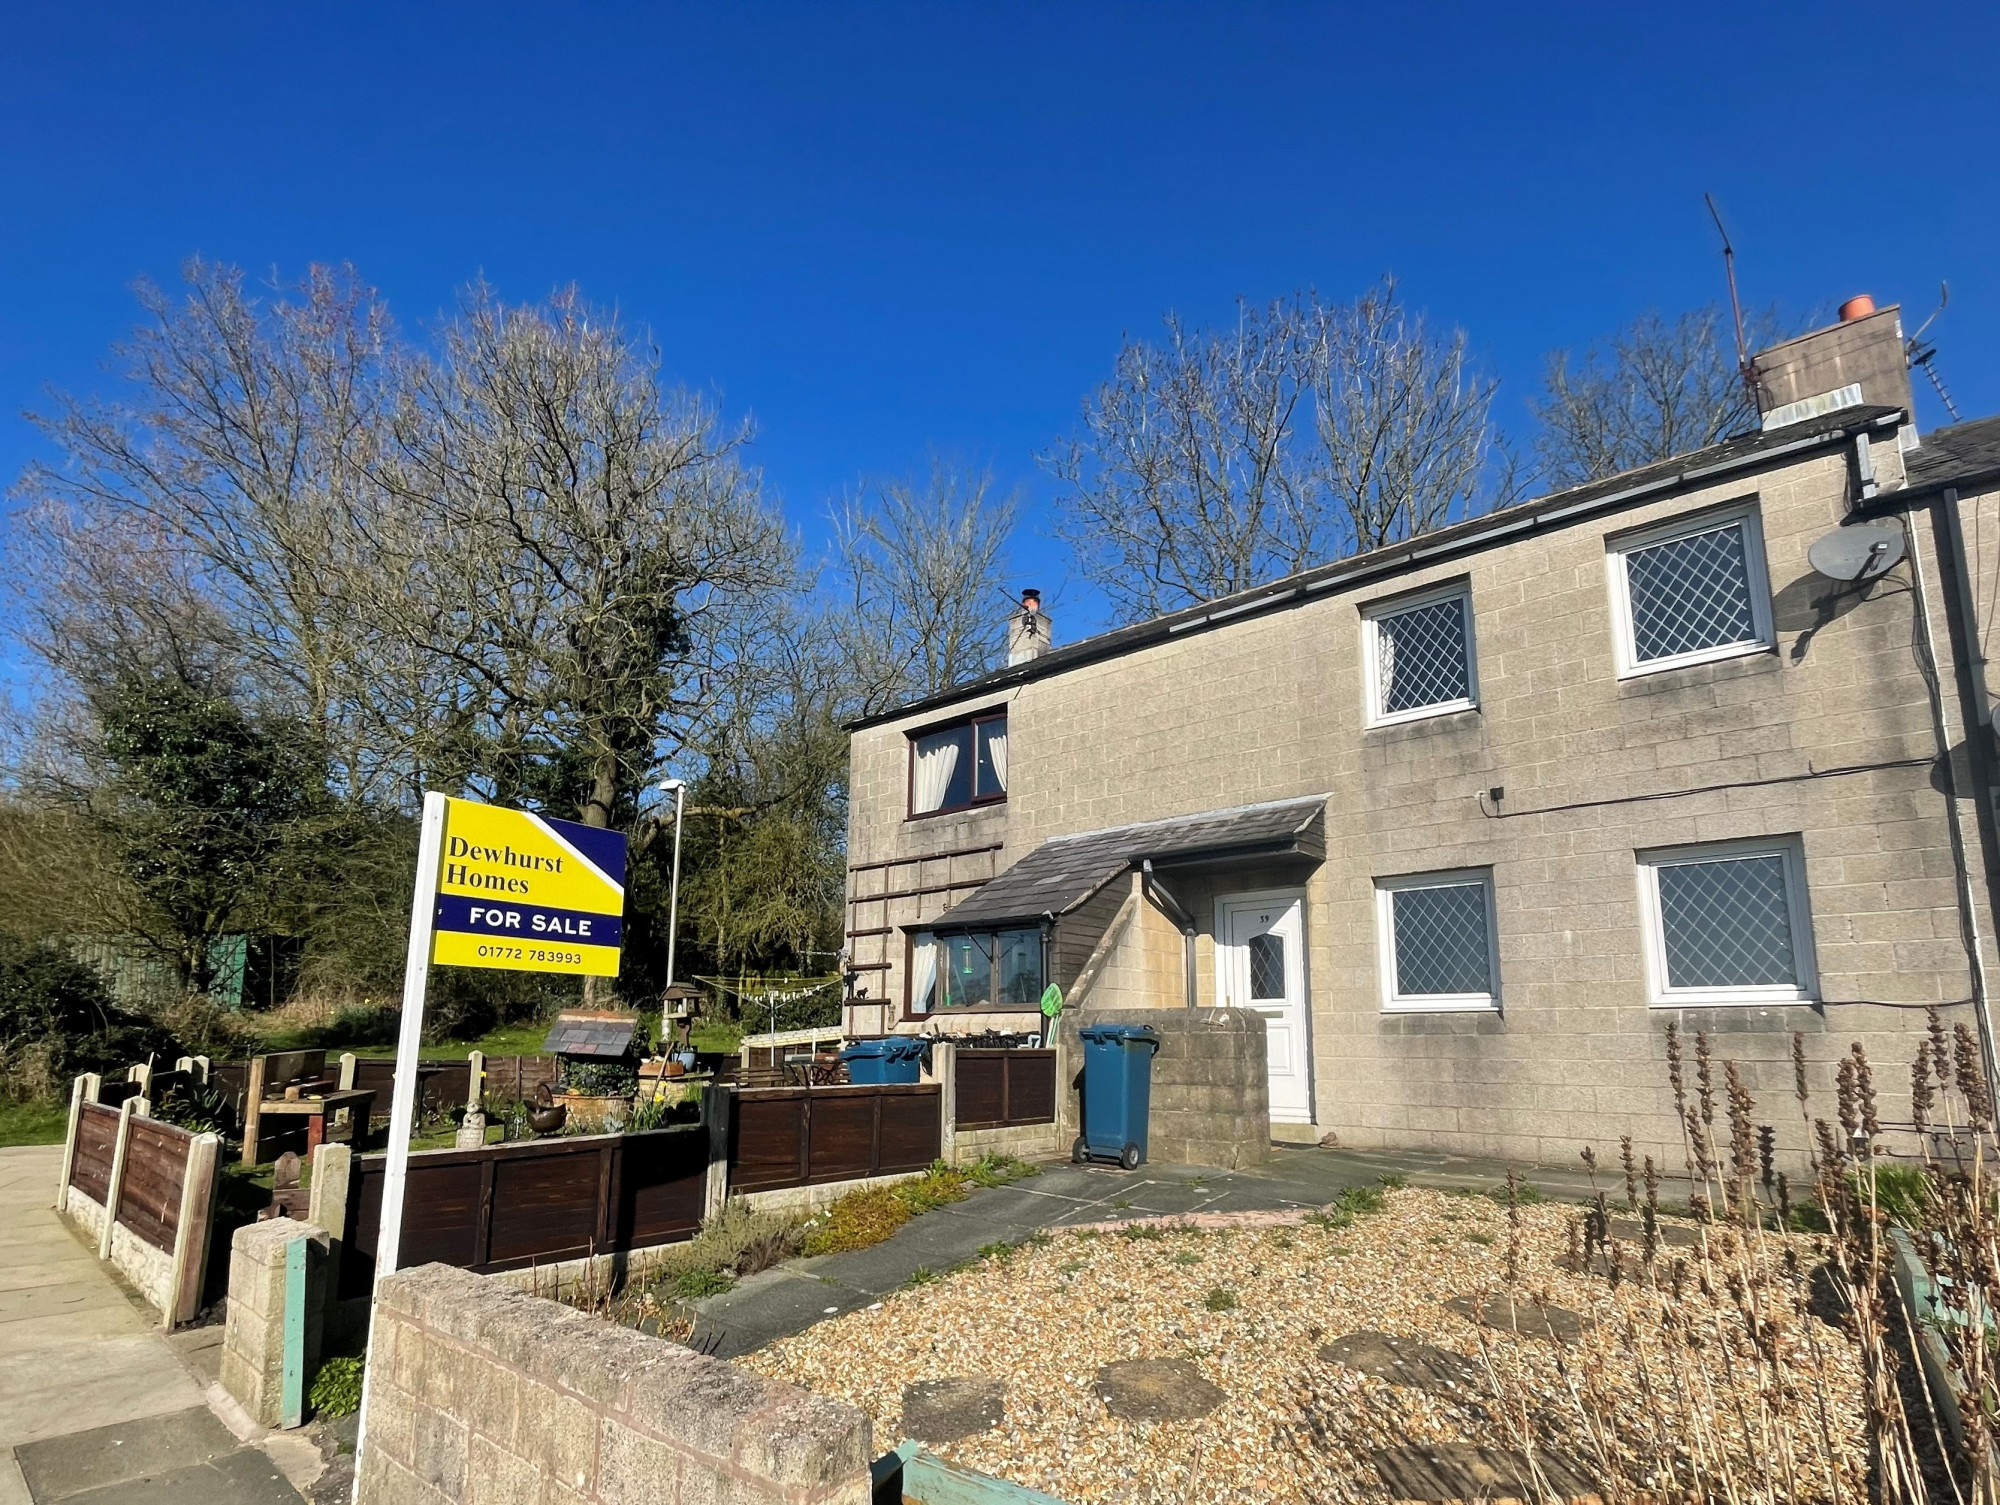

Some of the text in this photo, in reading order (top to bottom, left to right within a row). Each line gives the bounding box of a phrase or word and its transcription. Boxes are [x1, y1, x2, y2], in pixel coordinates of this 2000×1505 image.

[449, 836, 563, 873] Dewhurst
[447, 863, 529, 894] Homes
[470, 907, 592, 936] FOR SALE
[478, 945, 582, 964] 01772 783993
